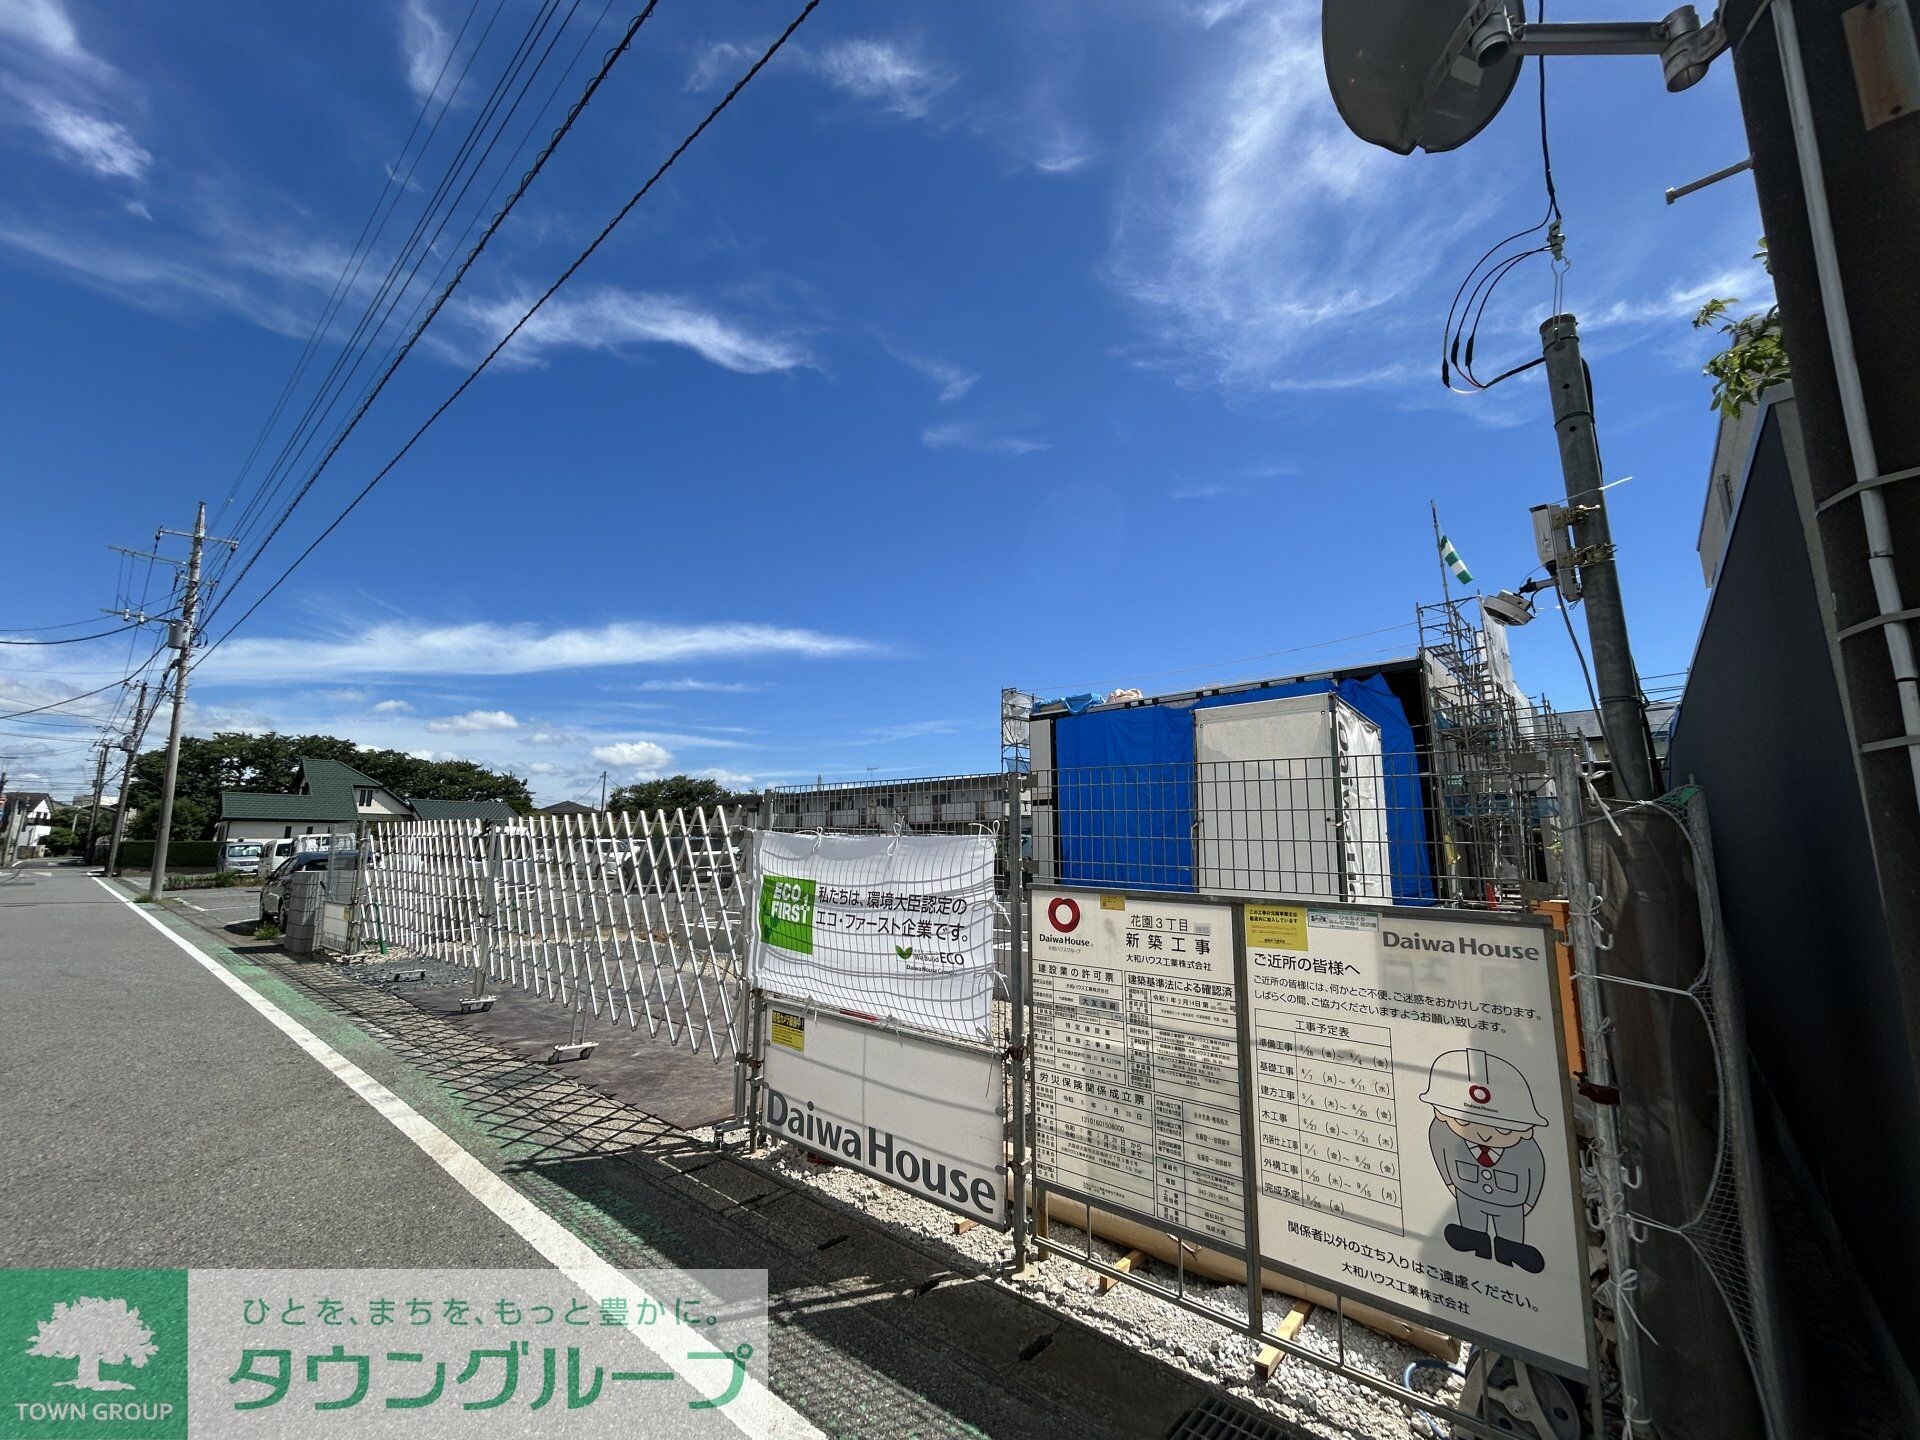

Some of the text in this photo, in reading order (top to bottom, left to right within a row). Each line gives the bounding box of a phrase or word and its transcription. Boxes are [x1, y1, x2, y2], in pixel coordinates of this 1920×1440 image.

[773, 882, 801, 901] ECO
[819, 886, 967, 915] 私たちは、環境大臣認定の
[770, 900, 810, 924] FIRST
[816, 910, 968, 942] エコ・ファースト企業です。
[1130, 915, 1188, 932] 花園3丁目
[1039, 933, 1090, 947] Daiwa House
[1126, 932, 1211, 955] 新築工事
[1383, 930, 1539, 961] Daiwa House
[940, 952, 964, 965] ECO
[1126, 954, 1212, 972] 大和ハウス工業株式会社
[1254, 952, 1361, 976] ご近所の皆様へ
[1039, 963, 1114, 983] 建設業の許可票
[1128, 974, 1232, 998] 建築基準法による確認済
[1253, 974, 1543, 1021] ご近所の皆様には、何かとご不便、ご迷惑をおかけしております。
[1253, 989, 1508, 1034] しばらくの間、ご協力くださいますようお願い致します。
[1295, 1020, 1350, 1038] 工事予定表
[1259, 1038, 1293, 1052] 準備工事
[1260, 1061, 1294, 1076] 基礎工事
[1040, 1072, 1145, 1106] 労災保険関係成立票
[1260, 1085, 1295, 1101] 建方工事
[1262, 1109, 1288, 1123] 木工事
[767, 1088, 996, 1214] Daiwa House
[1262, 1133, 1299, 1151] 内装仕上工事
[1263, 1157, 1299, 1175] 外構工事
[1264, 1182, 1300, 1201] 完成予定
[1287, 1219, 1540, 1312] 関係者以外の立ち入りはご遠慮ください。
[1342, 1261, 1471, 1315] 大和ハウス工業株式会社
